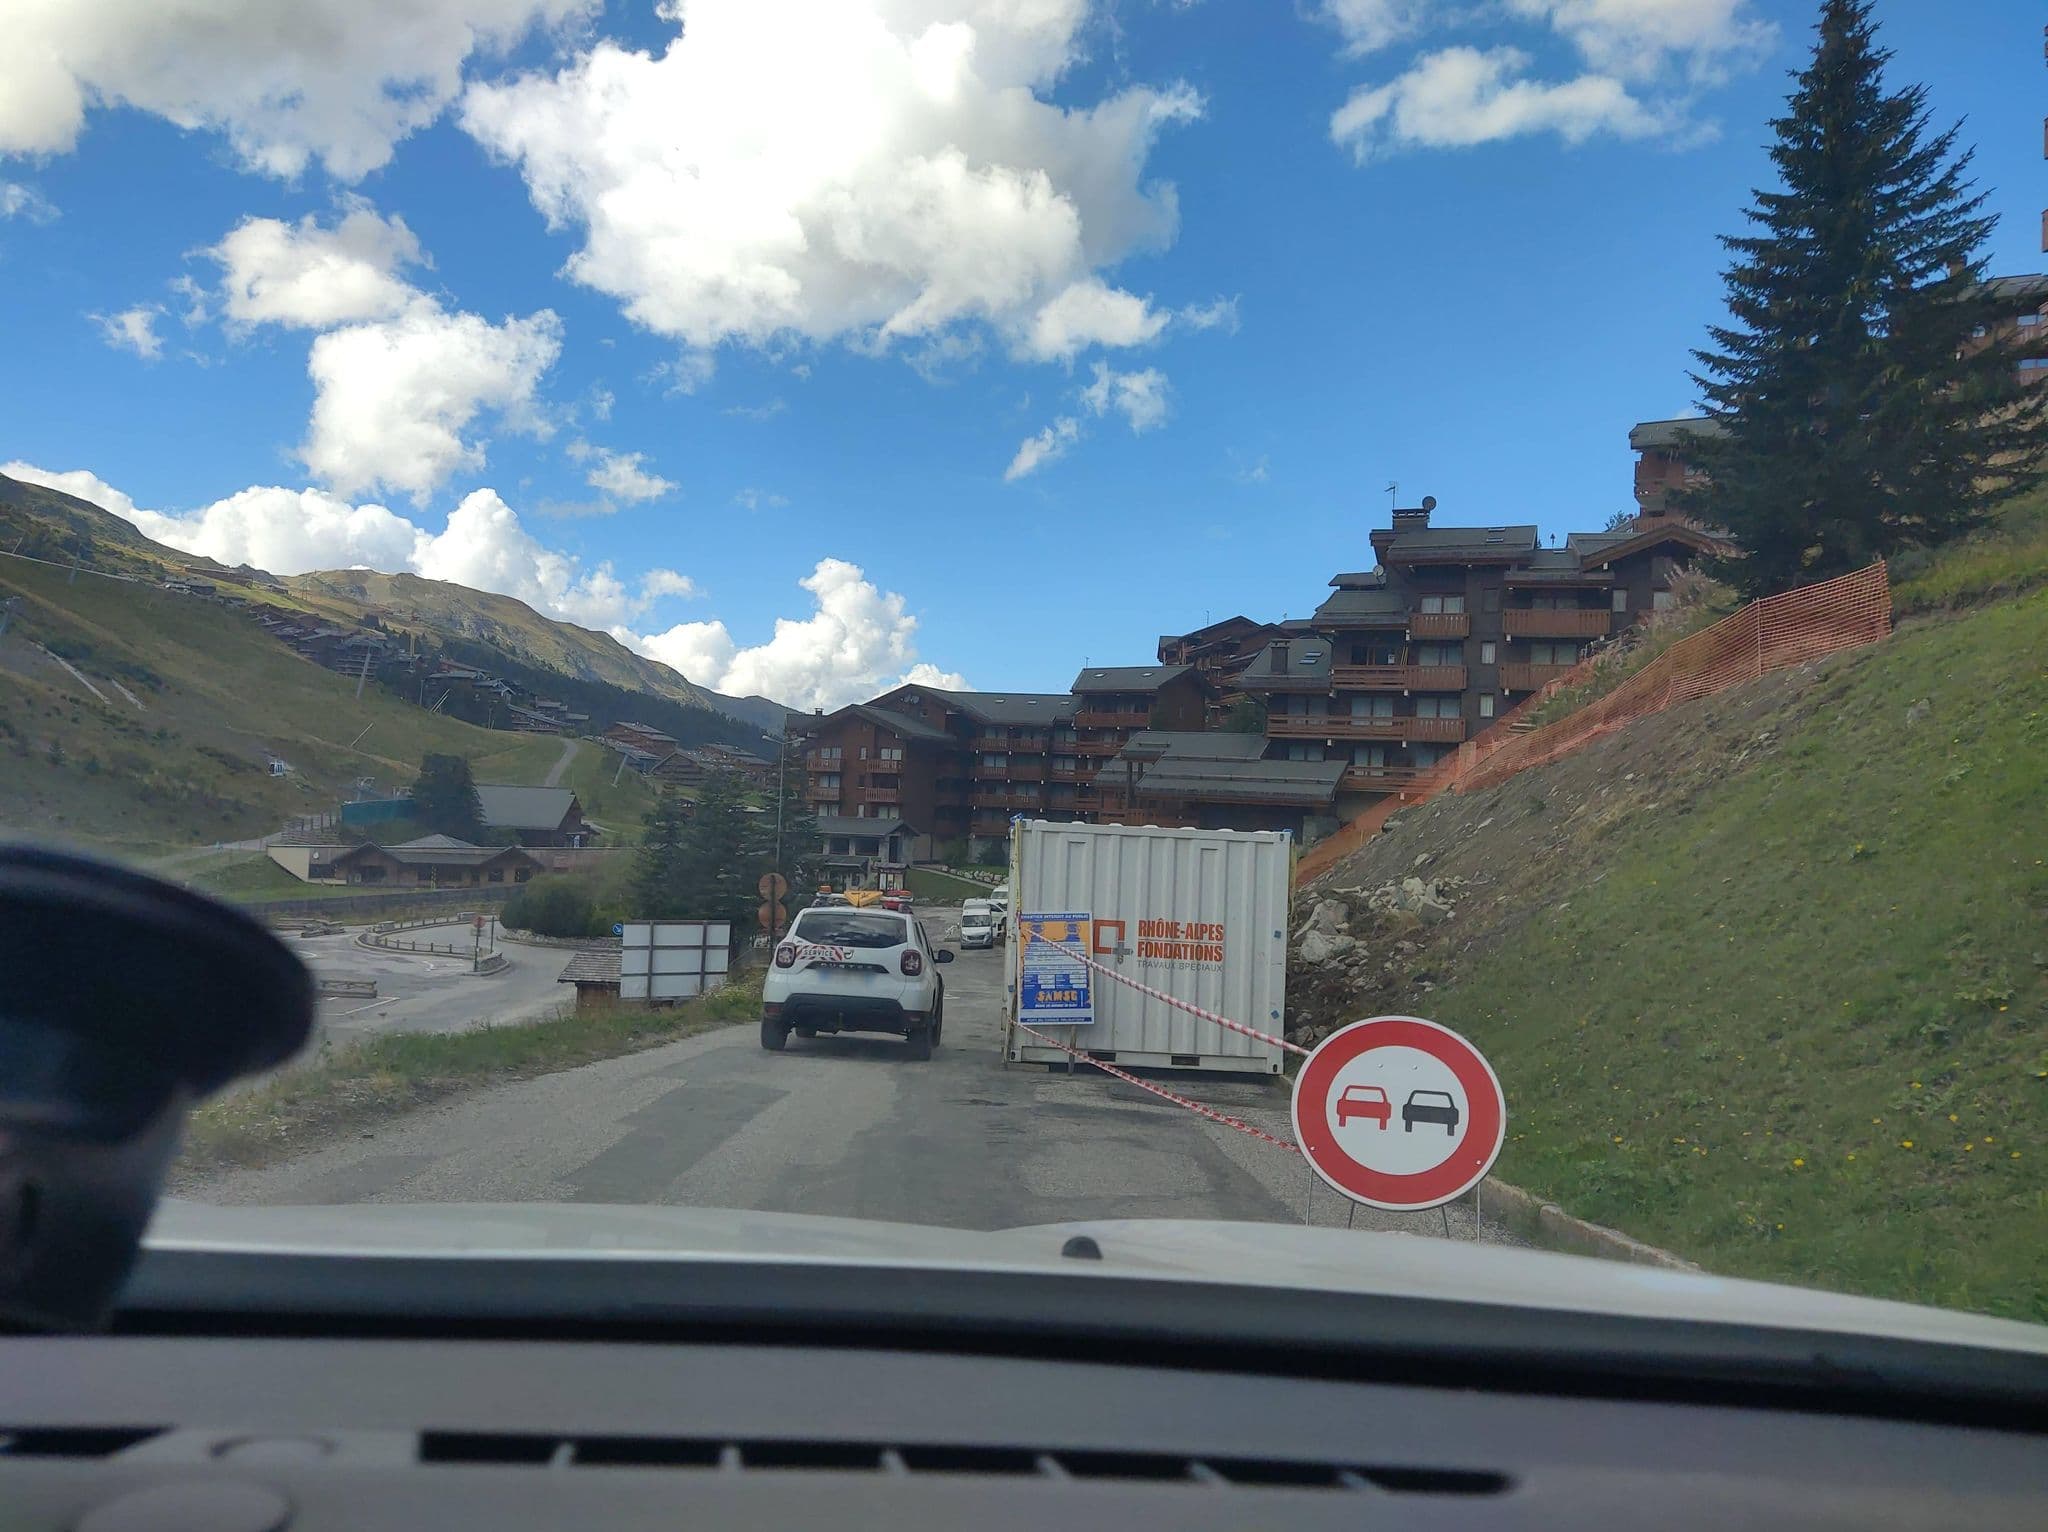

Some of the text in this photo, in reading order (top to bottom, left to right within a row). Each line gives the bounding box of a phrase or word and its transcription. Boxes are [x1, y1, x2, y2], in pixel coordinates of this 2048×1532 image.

[1138, 918, 1224, 941] RHÔNE-ALPES
[804, 949, 833, 957] SERVICE
[1137, 941, 1224, 962] FONDATIONS
[1137, 960, 1176, 970] TRAVAUX
